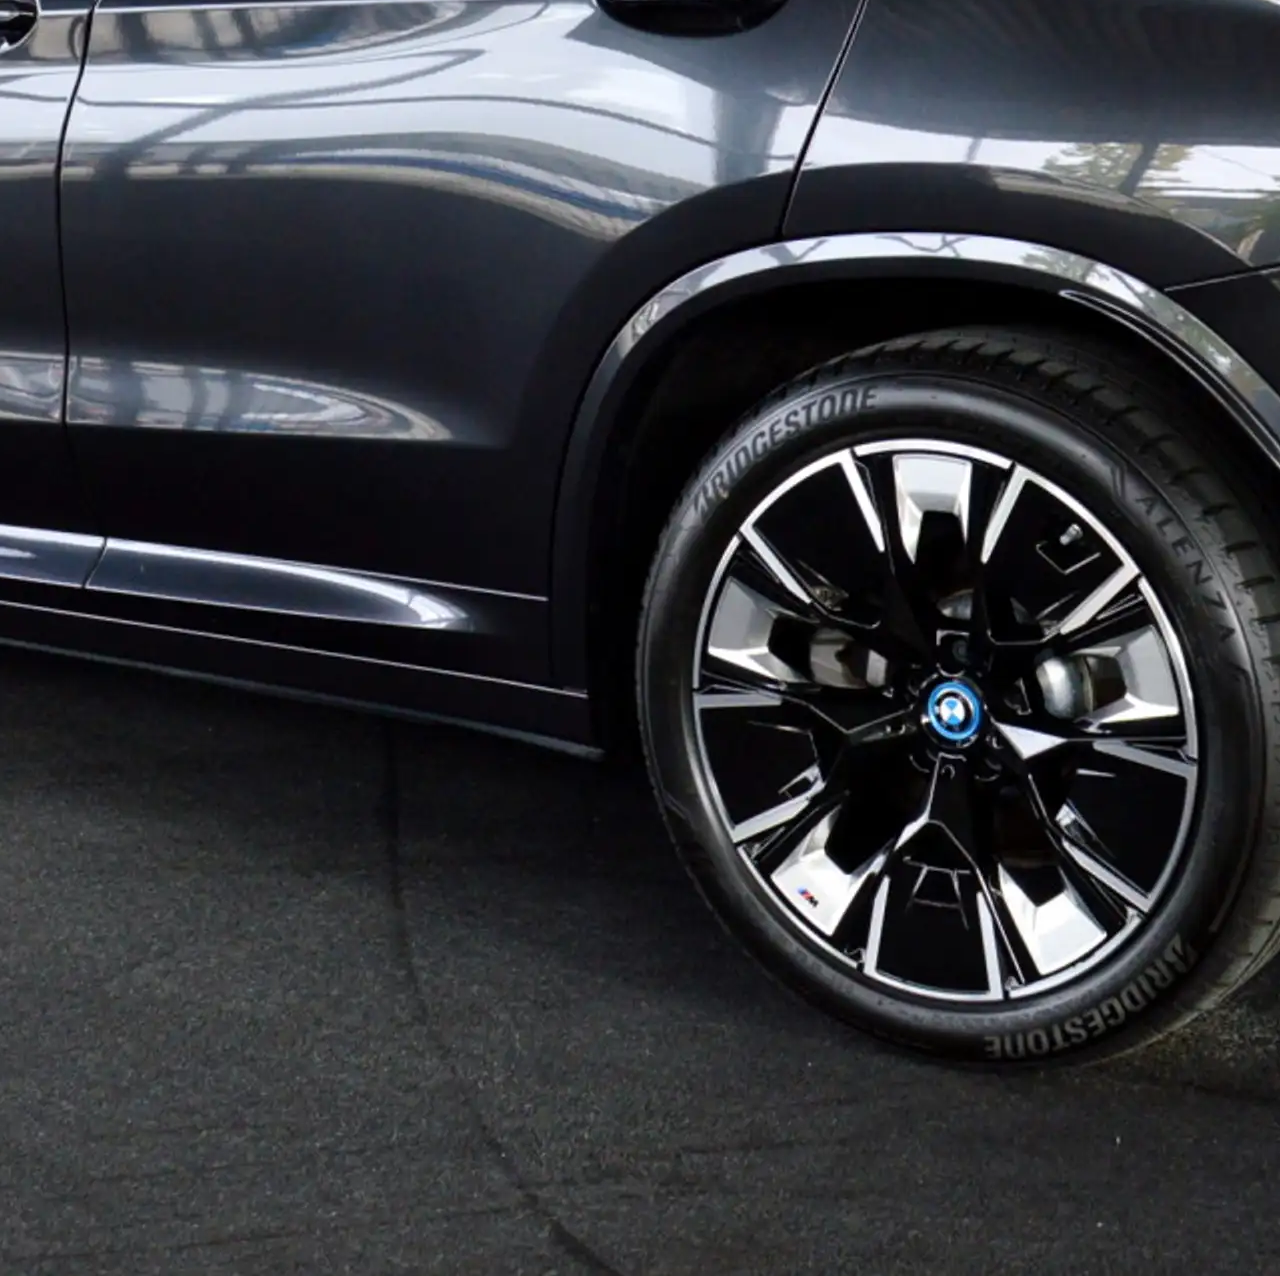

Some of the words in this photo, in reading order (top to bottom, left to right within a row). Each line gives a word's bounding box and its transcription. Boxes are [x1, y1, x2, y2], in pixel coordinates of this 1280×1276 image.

[693, 386, 877, 517] BRIDGESTONE
[1135, 496, 1235, 643] ALENZA
[984, 933, 1198, 1059] BRIDGESTONE
